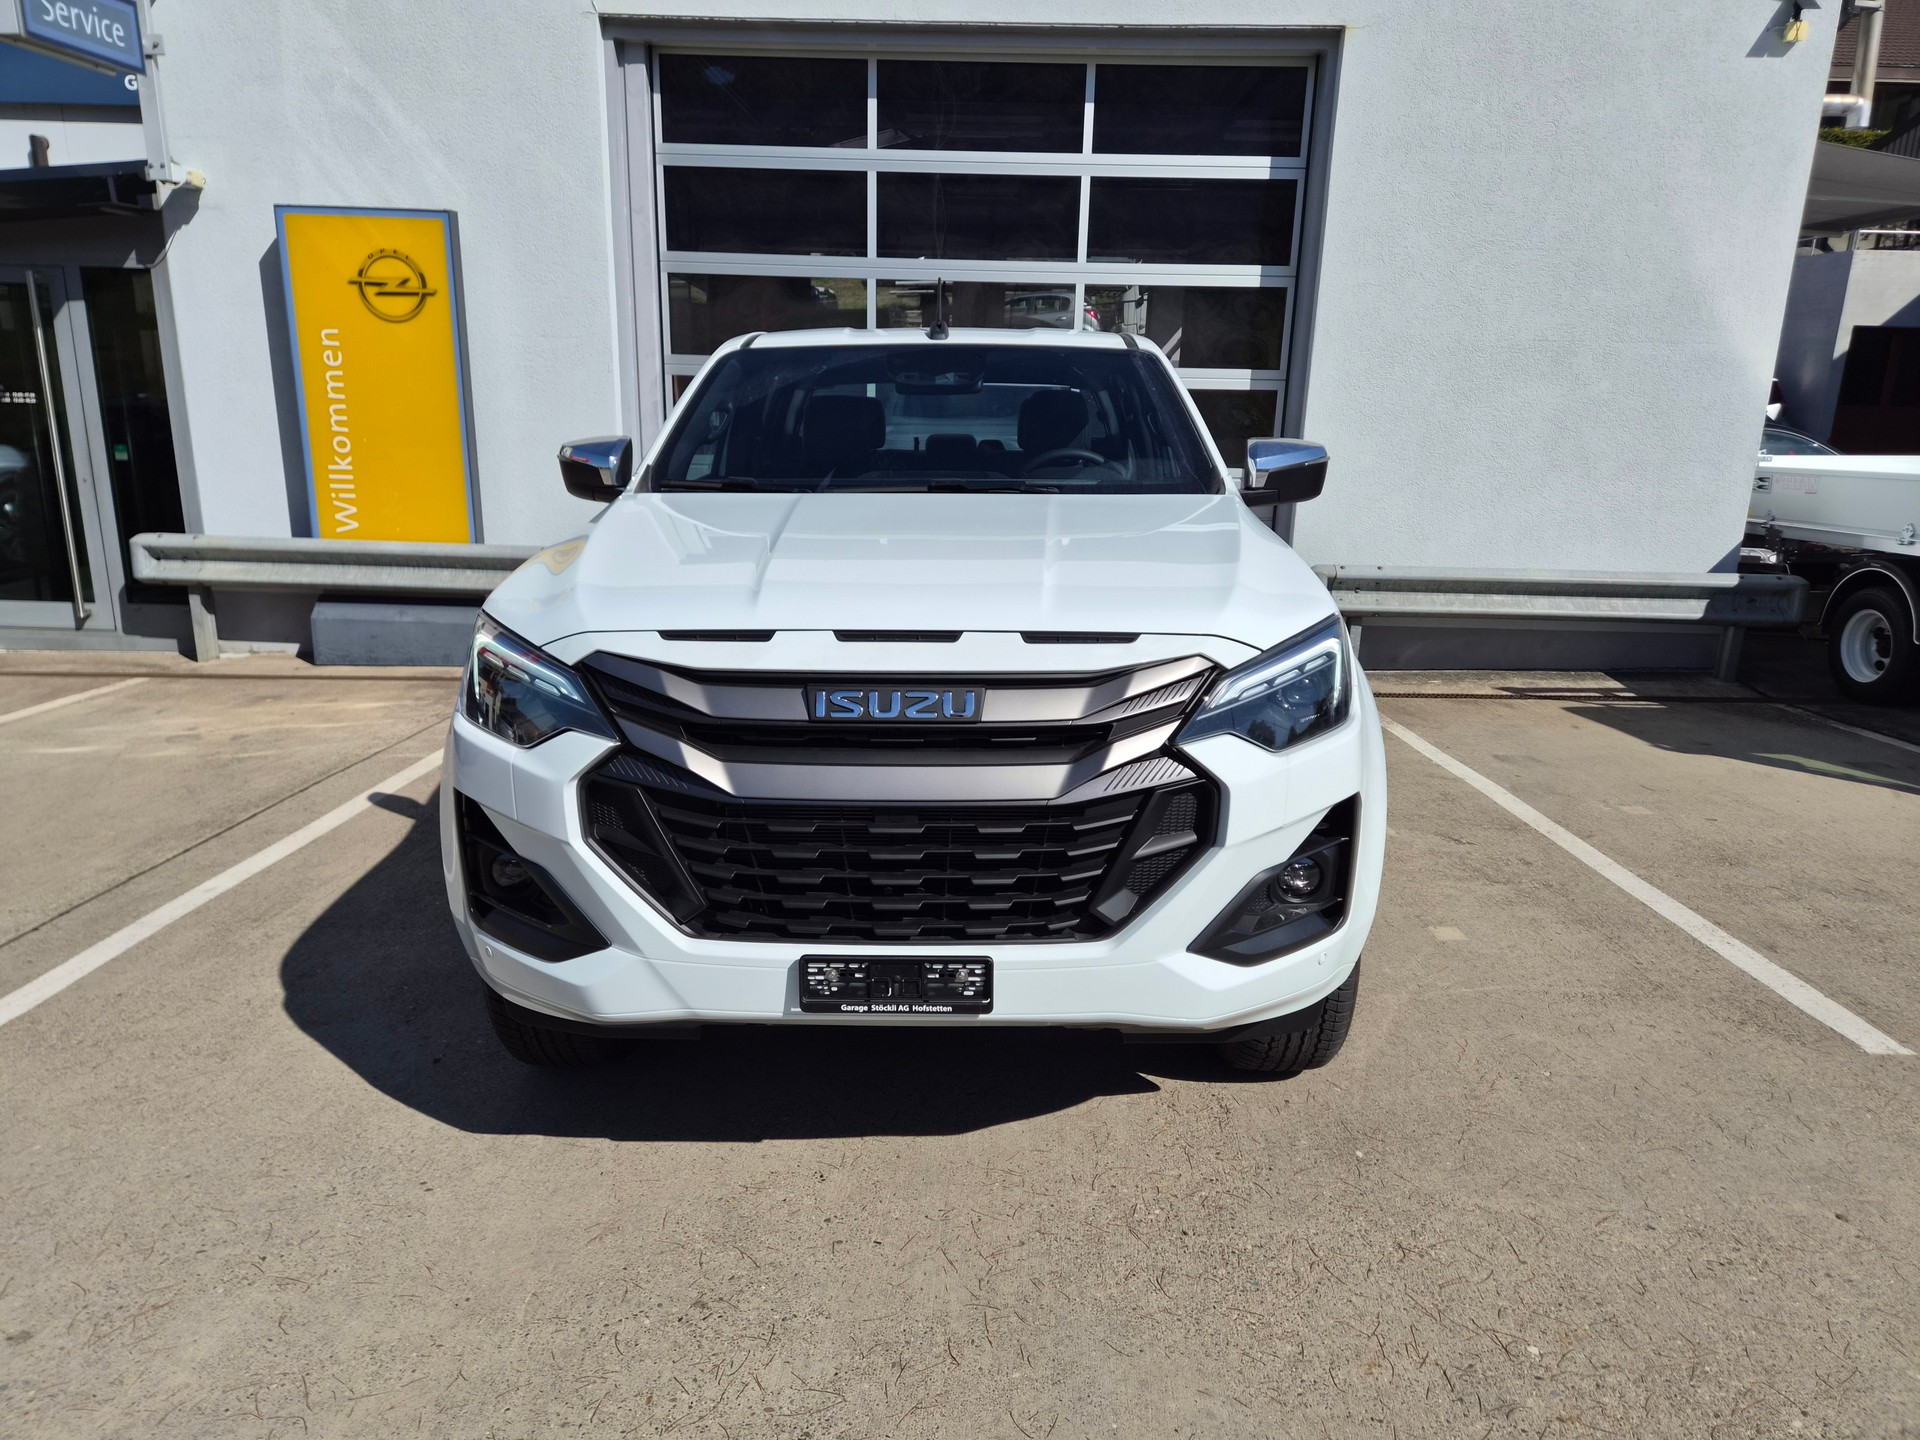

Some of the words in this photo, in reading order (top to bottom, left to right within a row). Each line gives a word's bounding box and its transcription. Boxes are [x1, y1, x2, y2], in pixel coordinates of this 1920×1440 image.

[42, 0, 125, 47] Service
[320, 328, 360, 534] Willkommen
[815, 690, 975, 718] ISUZU
[840, 1004, 868, 1013] Garage
[871, 1004, 897, 1012] Stöckli
[898, 1004, 910, 1012] AG
[912, 1004, 953, 1012] Hofstetten
